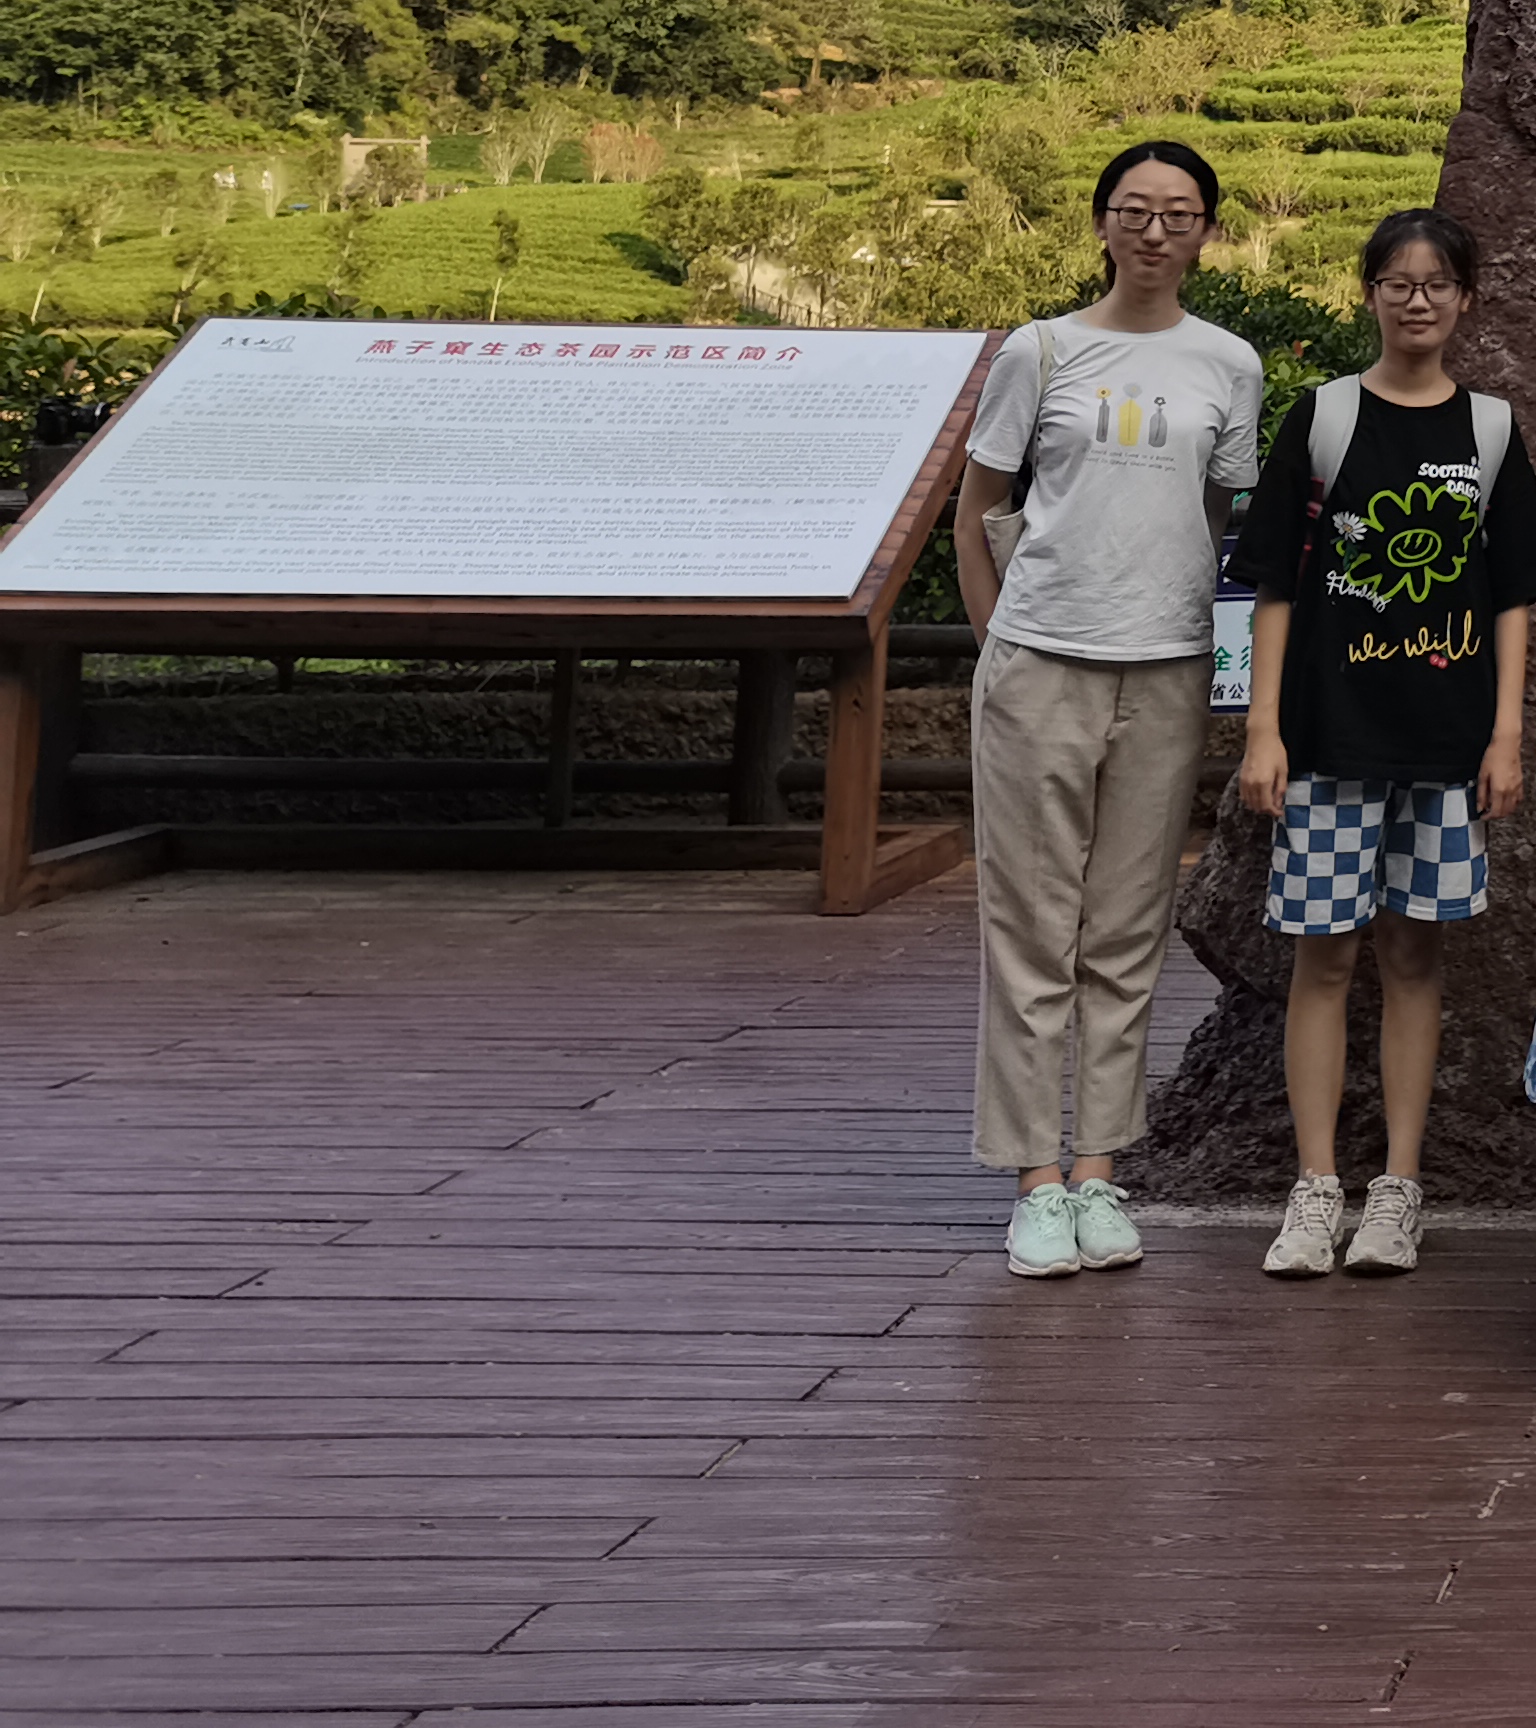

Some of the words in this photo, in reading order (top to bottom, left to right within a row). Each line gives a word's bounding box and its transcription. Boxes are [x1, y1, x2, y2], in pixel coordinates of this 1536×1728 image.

[355, 356, 436, 365] Introduction
[504, 358, 570, 368] Ecological
[1445, 479, 1481, 503] DAISY
[1348, 632, 1399, 663] we
[1404, 609, 1482, 661] will
[1211, 682, 1251, 701] 省公
